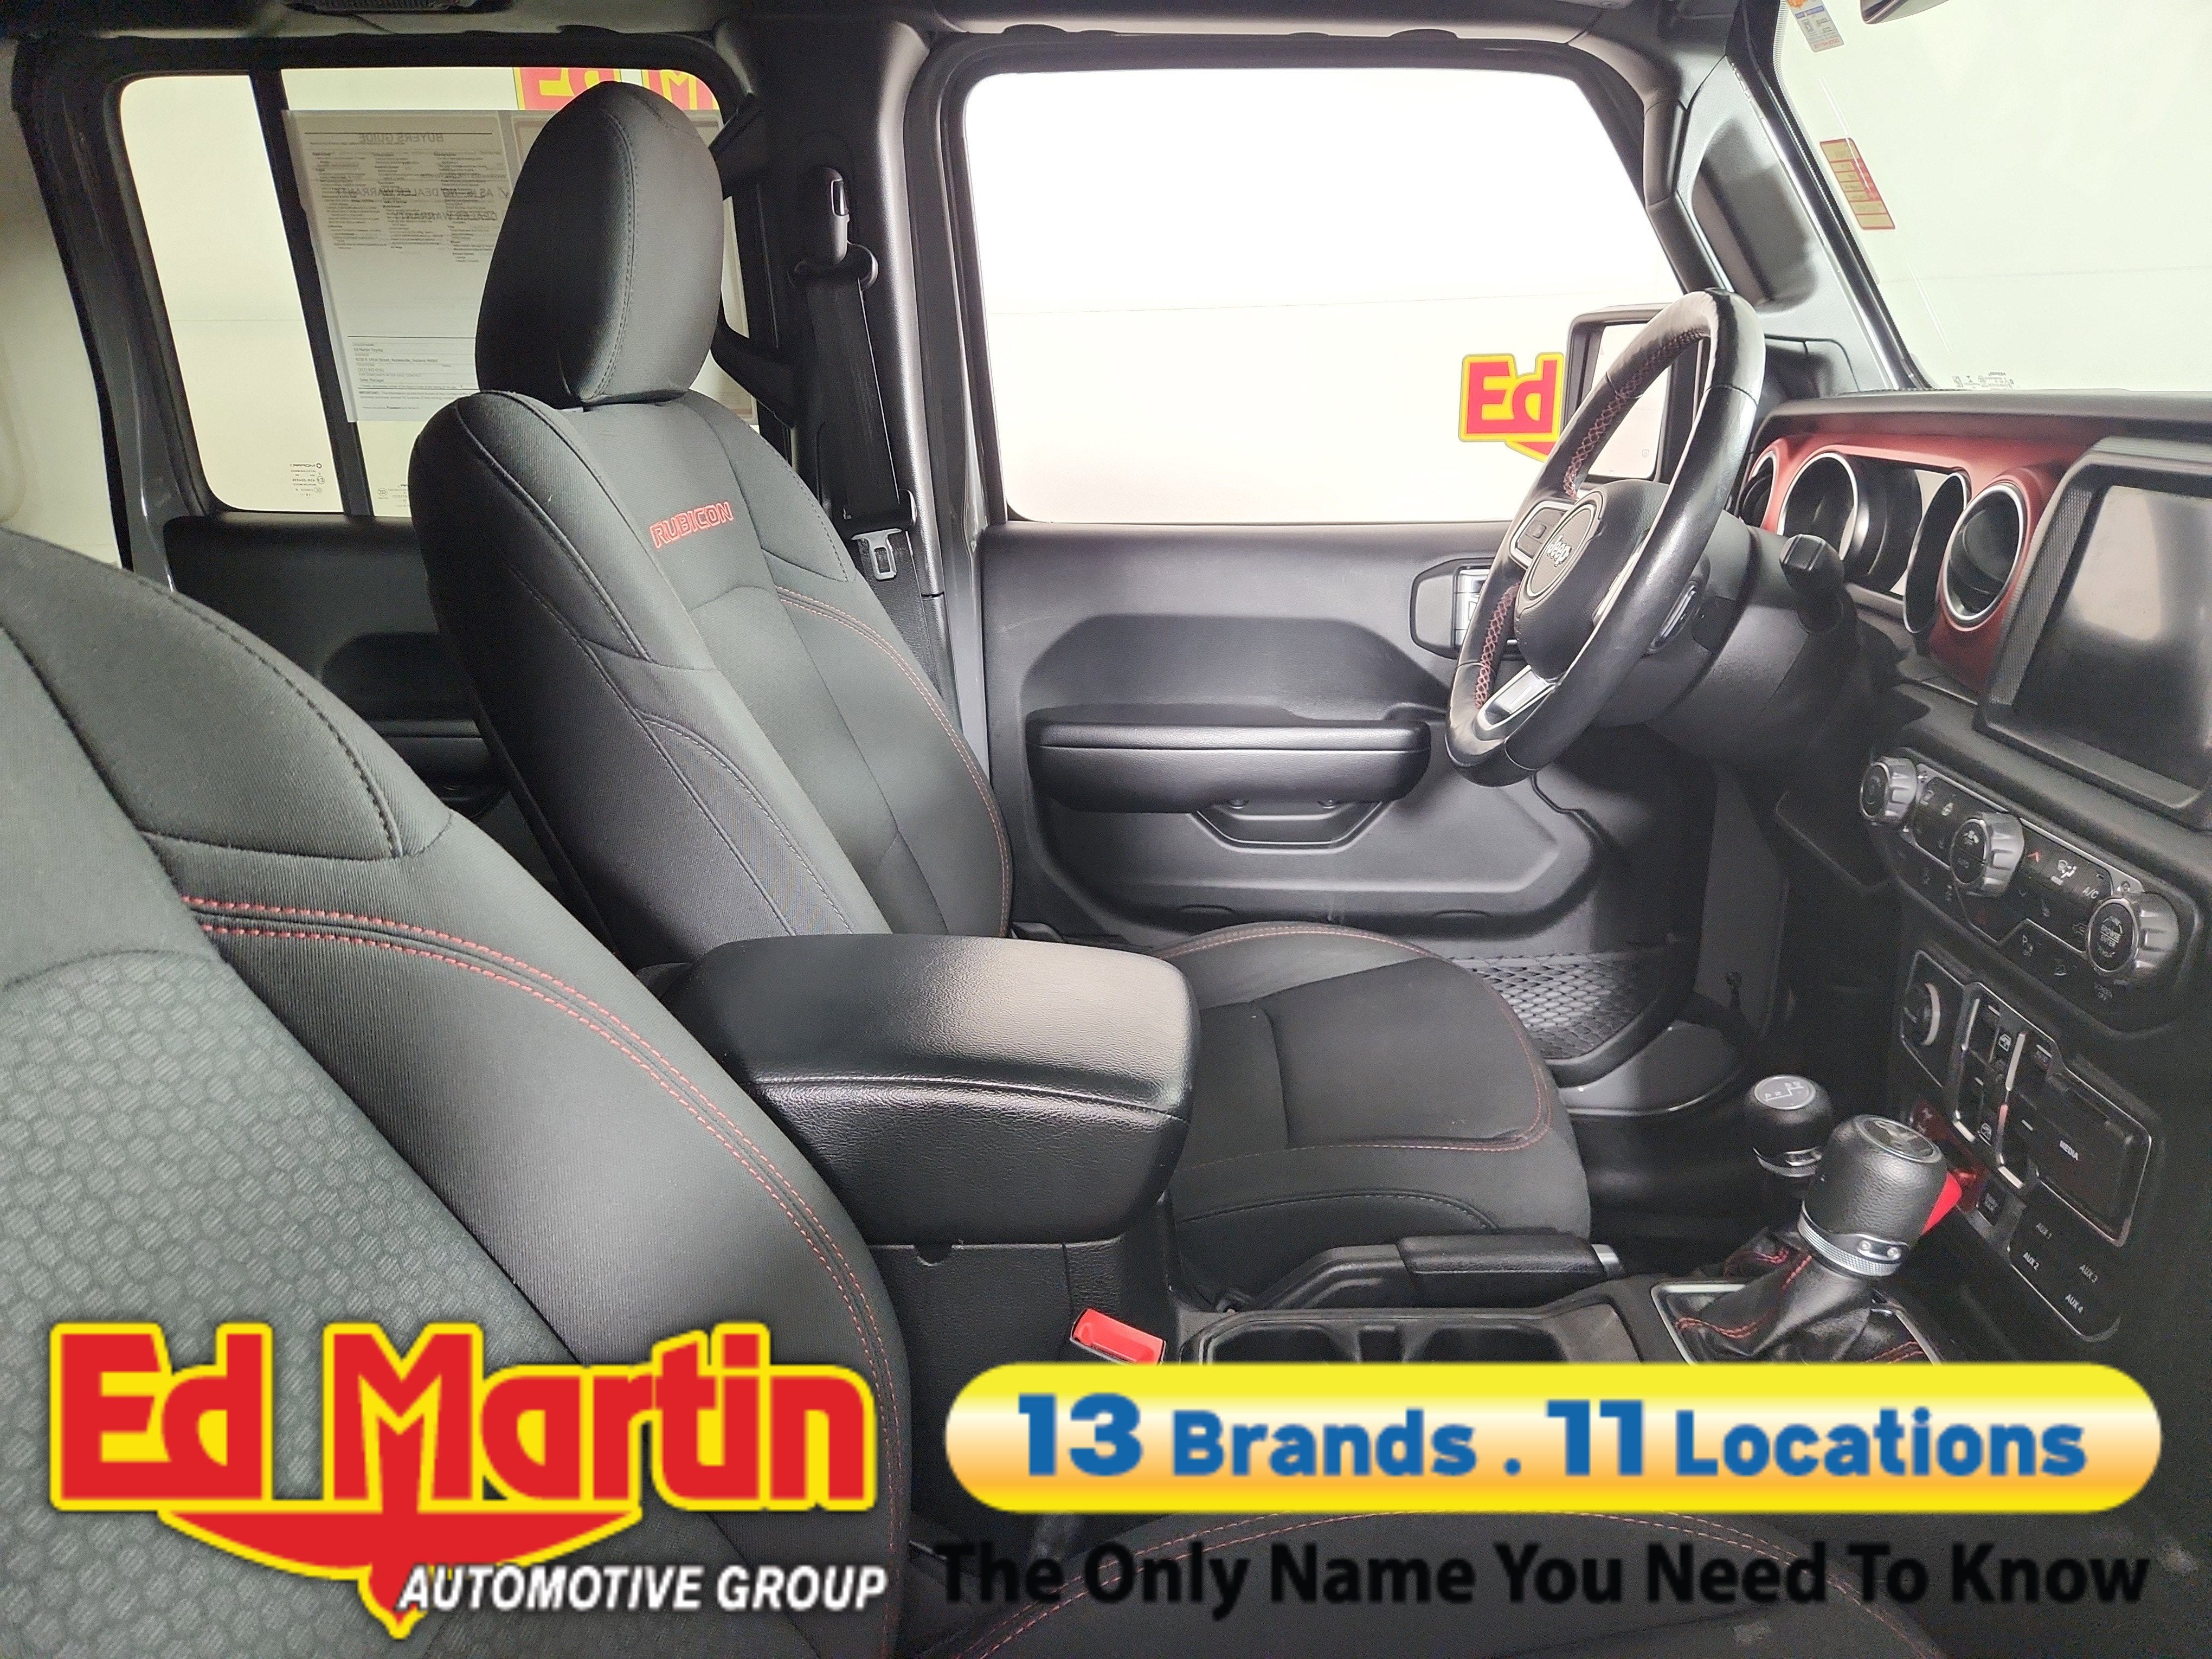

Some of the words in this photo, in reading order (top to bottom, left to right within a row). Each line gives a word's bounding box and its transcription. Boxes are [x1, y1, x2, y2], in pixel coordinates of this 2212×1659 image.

[1466, 359, 1558, 434] Ed
[649, 501, 734, 549] RUBICON
[1546, 535, 1572, 567] Jeep
[2082, 886, 2099, 899] A/C
[2059, 1140, 2079, 1161] MEDIA
[2036, 1223, 2049, 1237] AUX
[2023, 1252, 2036, 1266] AUX
[2034, 1262, 2040, 1271] 2
[2079, 1264, 2093, 1279] AUX
[2091, 1275, 2098, 1283] 3
[2065, 1294, 2080, 1310] AUX
